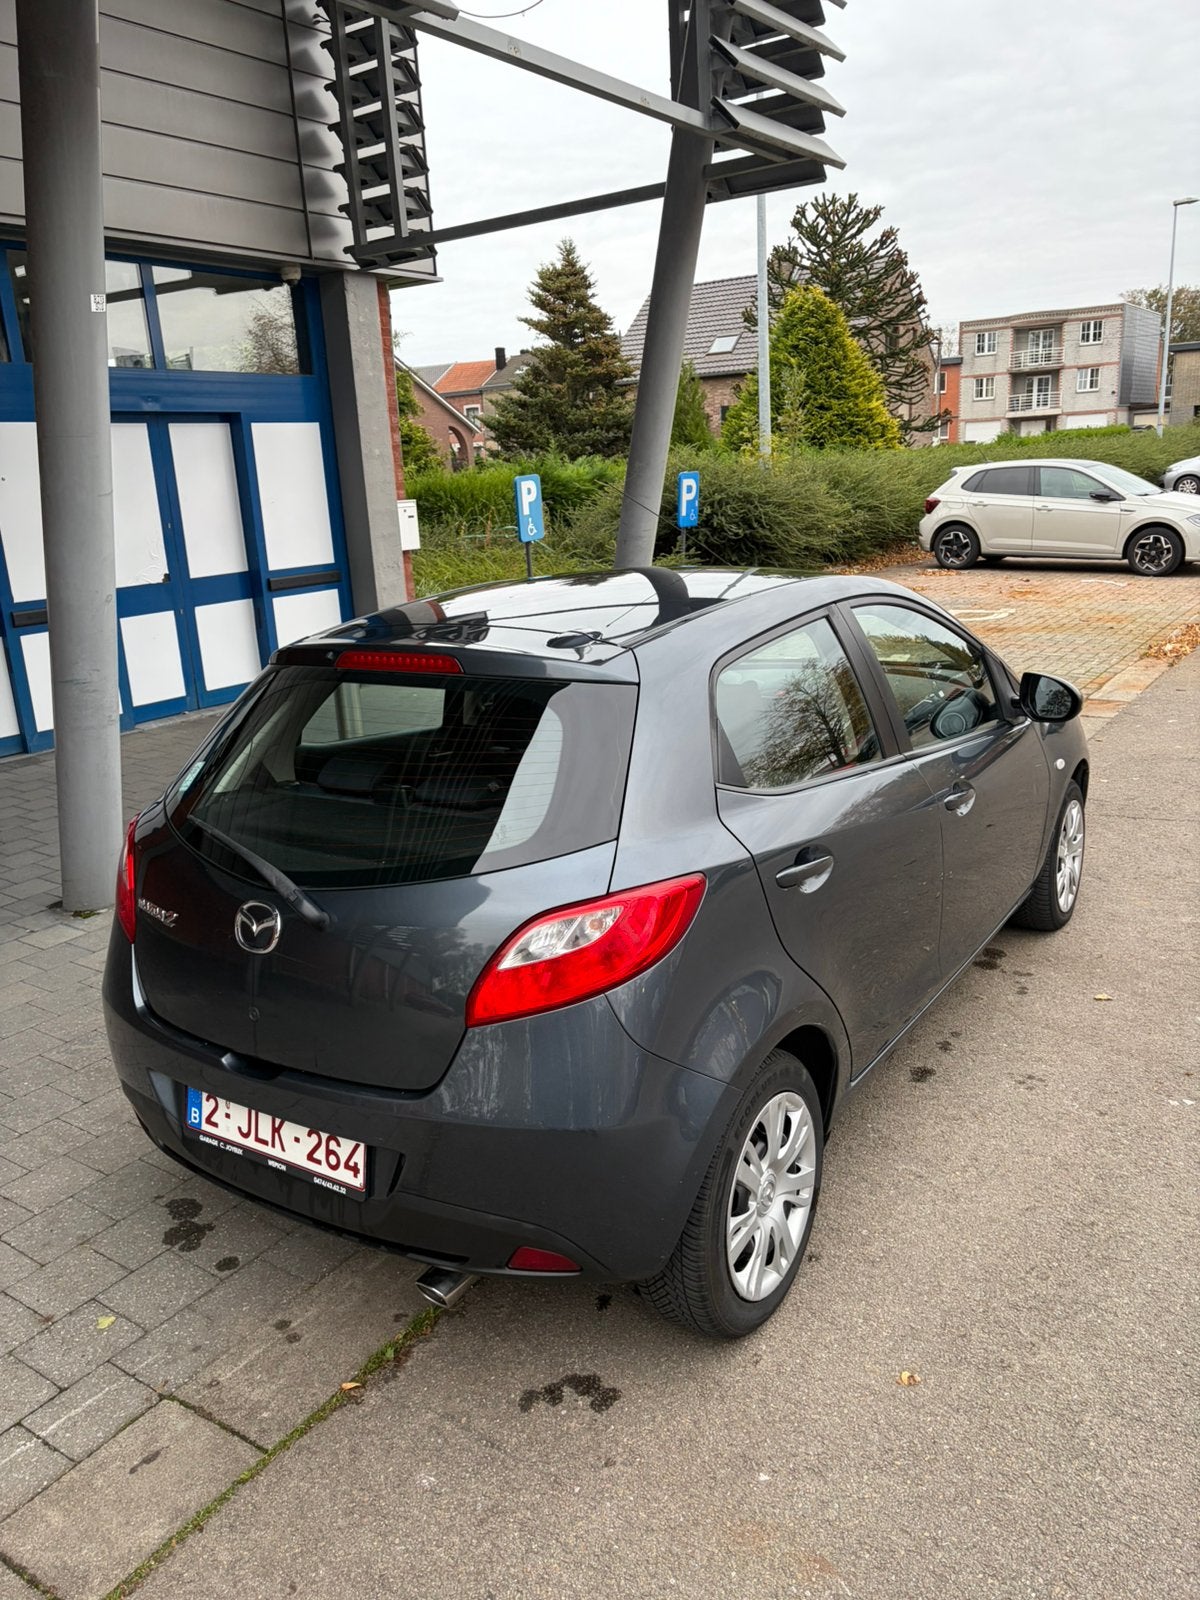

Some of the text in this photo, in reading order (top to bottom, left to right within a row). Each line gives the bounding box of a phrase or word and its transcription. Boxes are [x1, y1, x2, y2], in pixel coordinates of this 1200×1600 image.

[520, 480, 537, 516] P
[681, 479, 697, 517] P
[191, 1107, 200, 1123] B
[199, 1135, 218, 1147] GARAGE
